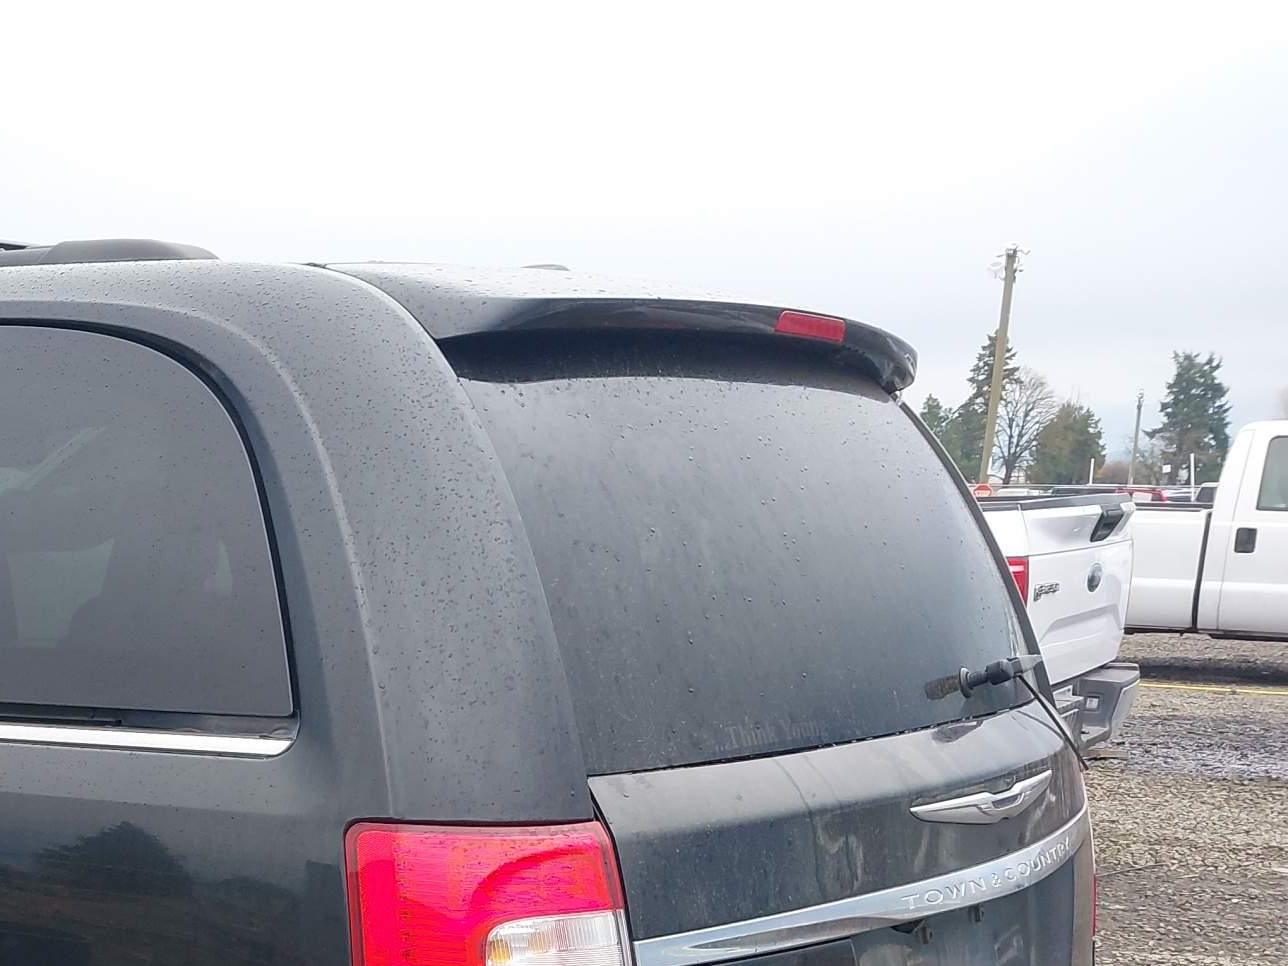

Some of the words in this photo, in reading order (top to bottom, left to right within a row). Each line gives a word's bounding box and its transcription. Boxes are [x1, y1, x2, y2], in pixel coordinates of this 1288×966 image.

[901, 876, 987, 910] TOWN
[991, 872, 1003, 888] &
[1004, 836, 1070, 883] COUNTRY
